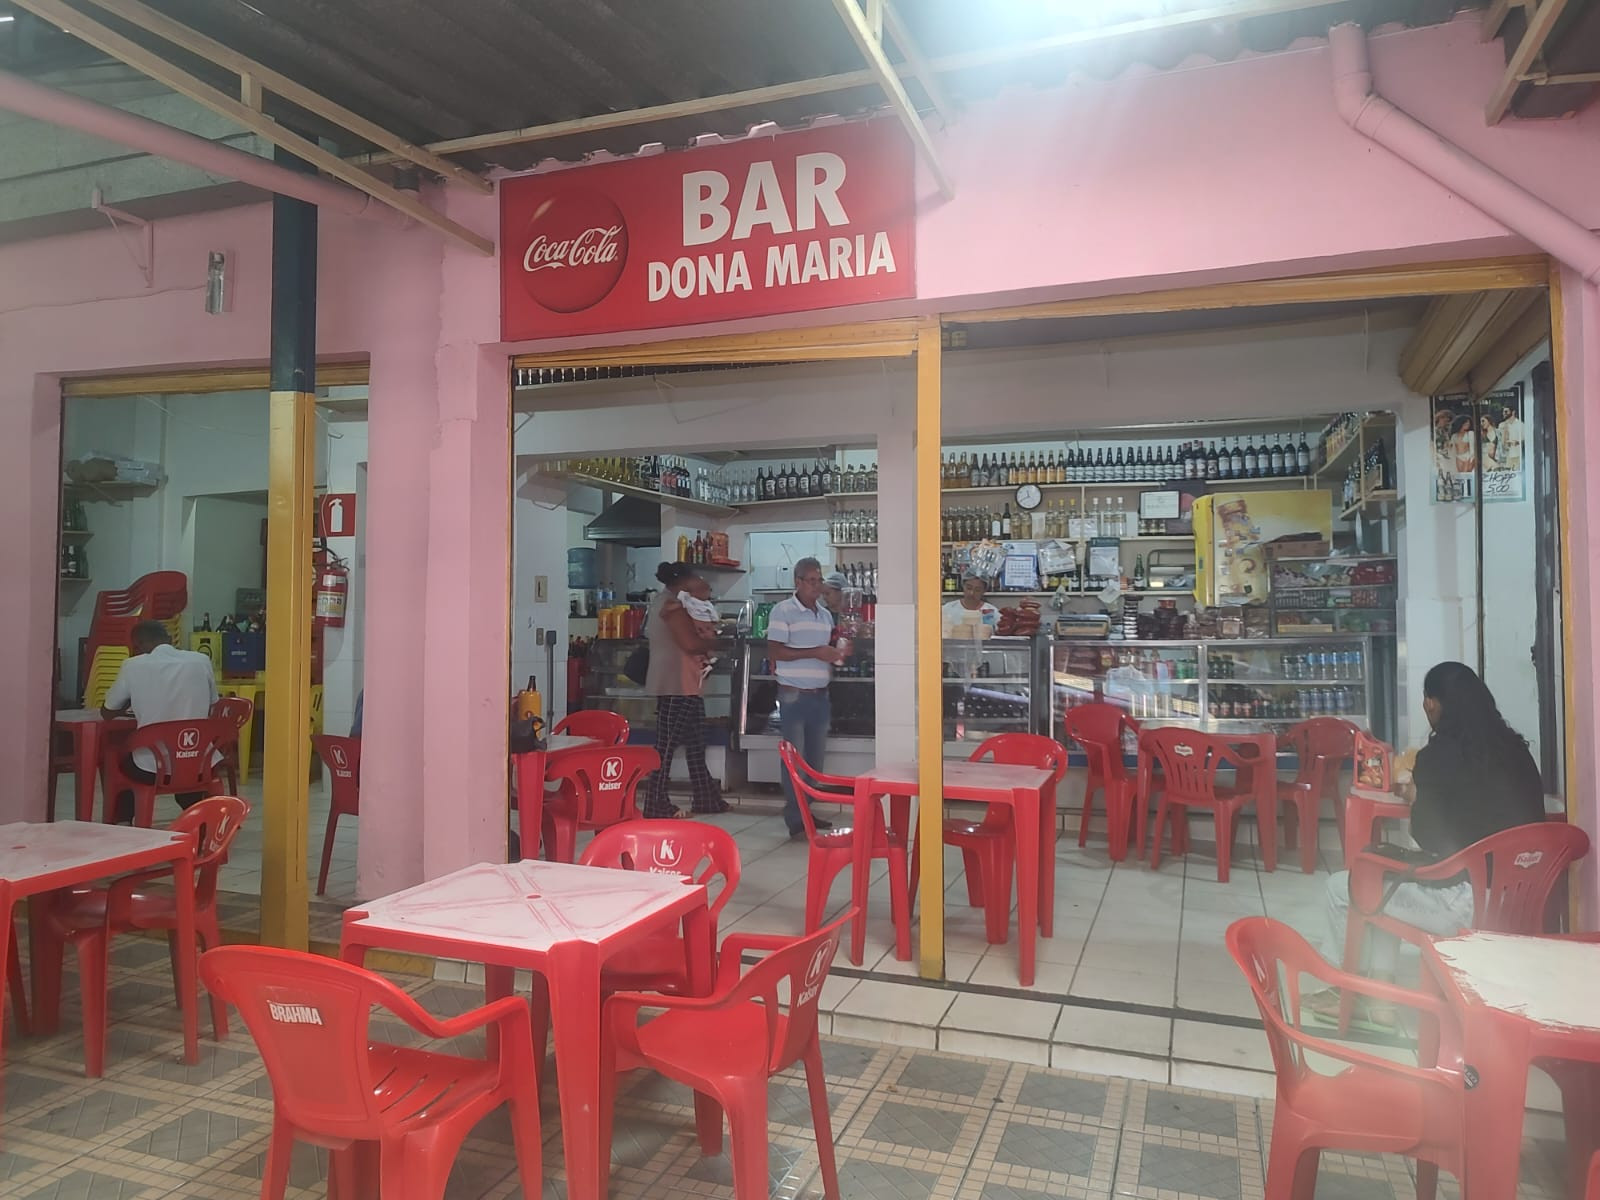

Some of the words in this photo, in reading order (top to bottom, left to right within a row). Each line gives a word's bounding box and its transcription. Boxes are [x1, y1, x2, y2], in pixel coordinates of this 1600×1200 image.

[682, 151, 850, 247] BAR
[523, 225, 624, 272] Coca-Cola
[648, 250, 753, 303] DONA
[764, 231, 897, 288] MARIA
[598, 781, 622, 792] Kaiser
[606, 761, 619, 777] K
[267, 1001, 323, 1026] BRAHMA
